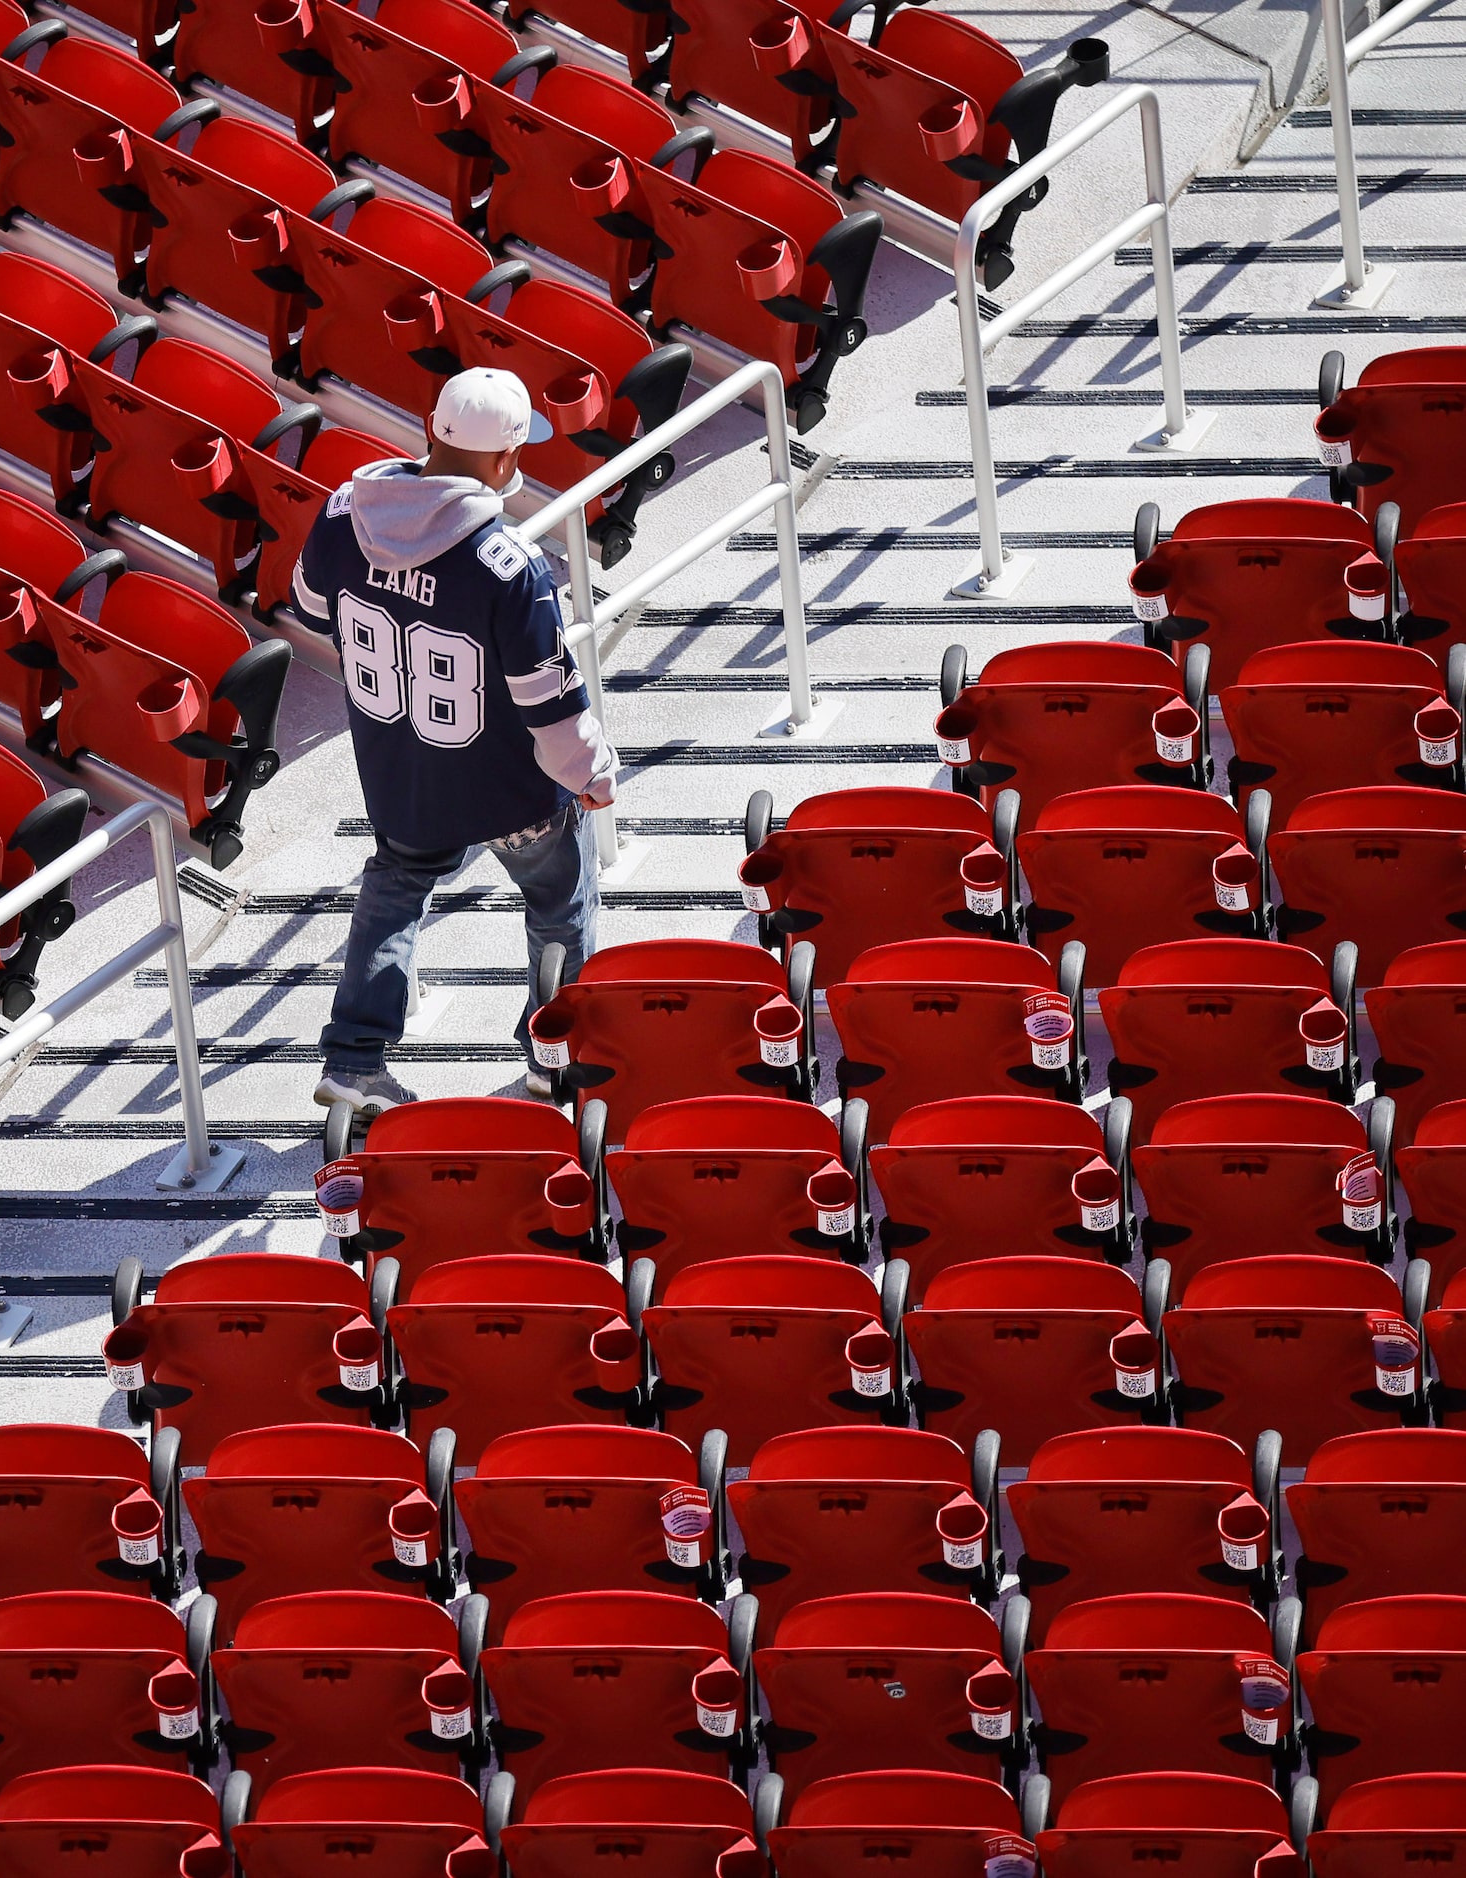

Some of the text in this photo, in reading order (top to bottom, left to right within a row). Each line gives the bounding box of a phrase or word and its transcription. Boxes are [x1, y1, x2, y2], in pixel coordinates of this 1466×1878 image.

[1028, 185, 1037, 200] 4
[847, 329, 856, 345] 5
[654, 464, 663, 480] 6
[366, 566, 438, 607] LAMB
[338, 589, 486, 749] 88
